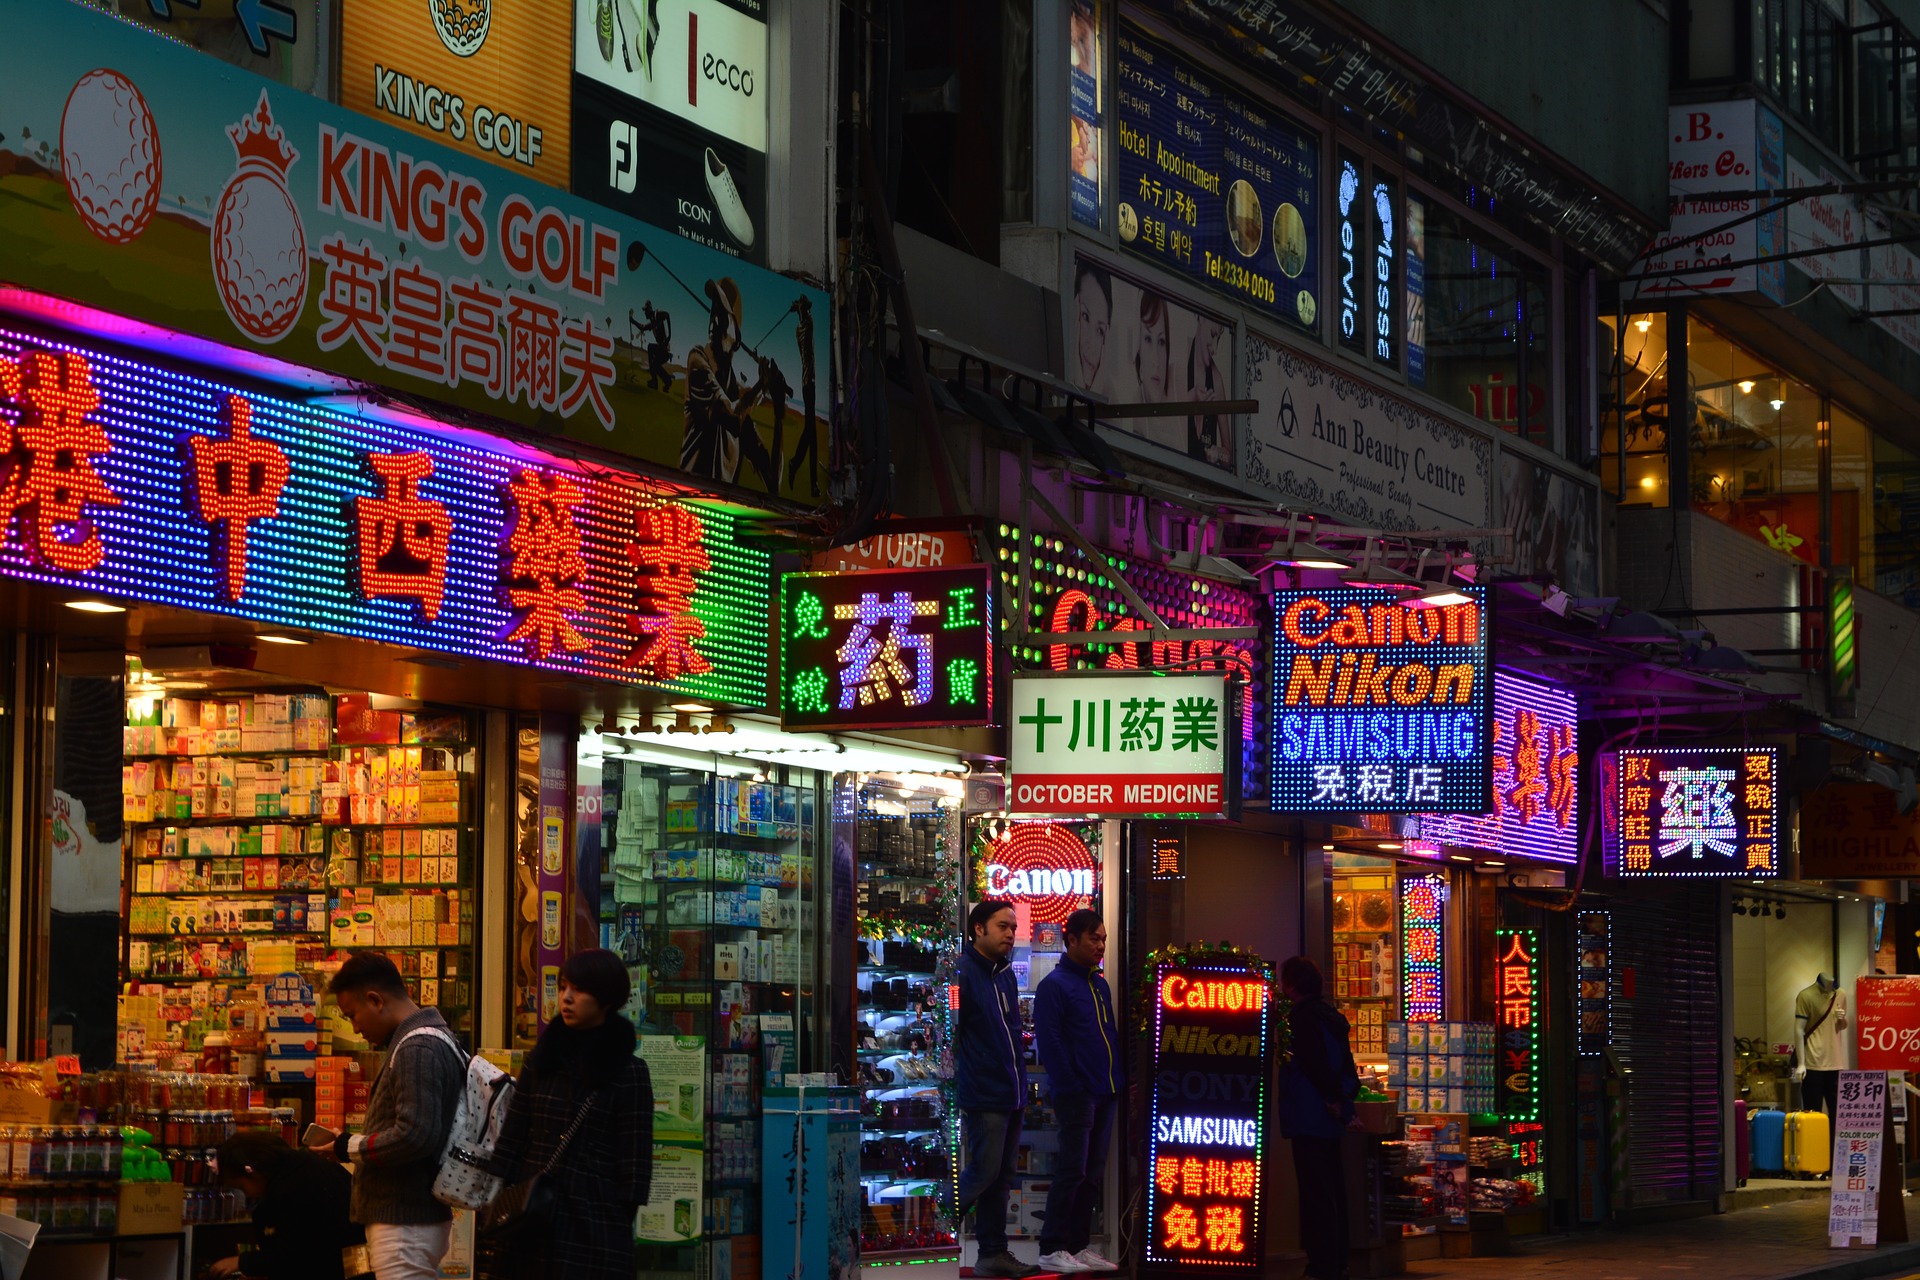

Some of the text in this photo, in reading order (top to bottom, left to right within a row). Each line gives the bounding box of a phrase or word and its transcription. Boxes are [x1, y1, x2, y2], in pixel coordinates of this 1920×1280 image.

[703, 52, 754, 97] ecco
[375, 64, 543, 167] KING'S GOLF
[609, 119, 639, 194] FJ
[1119, 119, 1220, 196] Hotel Appointment
[320, 128, 618, 301] KING'S GOLF
[677, 197, 712, 226] ICON
[1139, 172, 1197, 228] ホテル予約
[677, 225, 690, 239] The
[690, 230, 706, 245] Mark
[1142, 215, 1166, 252] 호텔
[1251, 272, 1276, 304] 0016
[317, 235, 615, 428] 英皇高爾夫
[1312, 402, 1466, 496] Ann Beauty Centre
[1339, 461, 1413, 511] Professional Beauty
[843, 532, 946, 568] CTOBER
[1283, 598, 1478, 648] Canon
[1284, 652, 1476, 706] Nikon
[1281, 712, 1478, 762] SAMSUNG
[1017, 783, 1220, 804] OCTOBER MEDICINE
[1657, 765, 1738, 859] 藥
[1624, 756, 1653, 871] 政府註冊
[985, 863, 1093, 896] Canon
[1161, 975, 1264, 1010] Canon
[1858, 1013, 1882, 1023] Up to
[1159, 1025, 1260, 1058] Nikon
[1859, 1026, 1920, 1053] 50%
[1159, 1070, 1260, 1102] SONY
[1839, 1081, 1884, 1102] 影印
[1158, 1115, 1256, 1146] SAMSUNG
[1839, 1131, 1880, 1139] COLOR COPY
[1156, 1157, 1256, 1197] 零售批發
